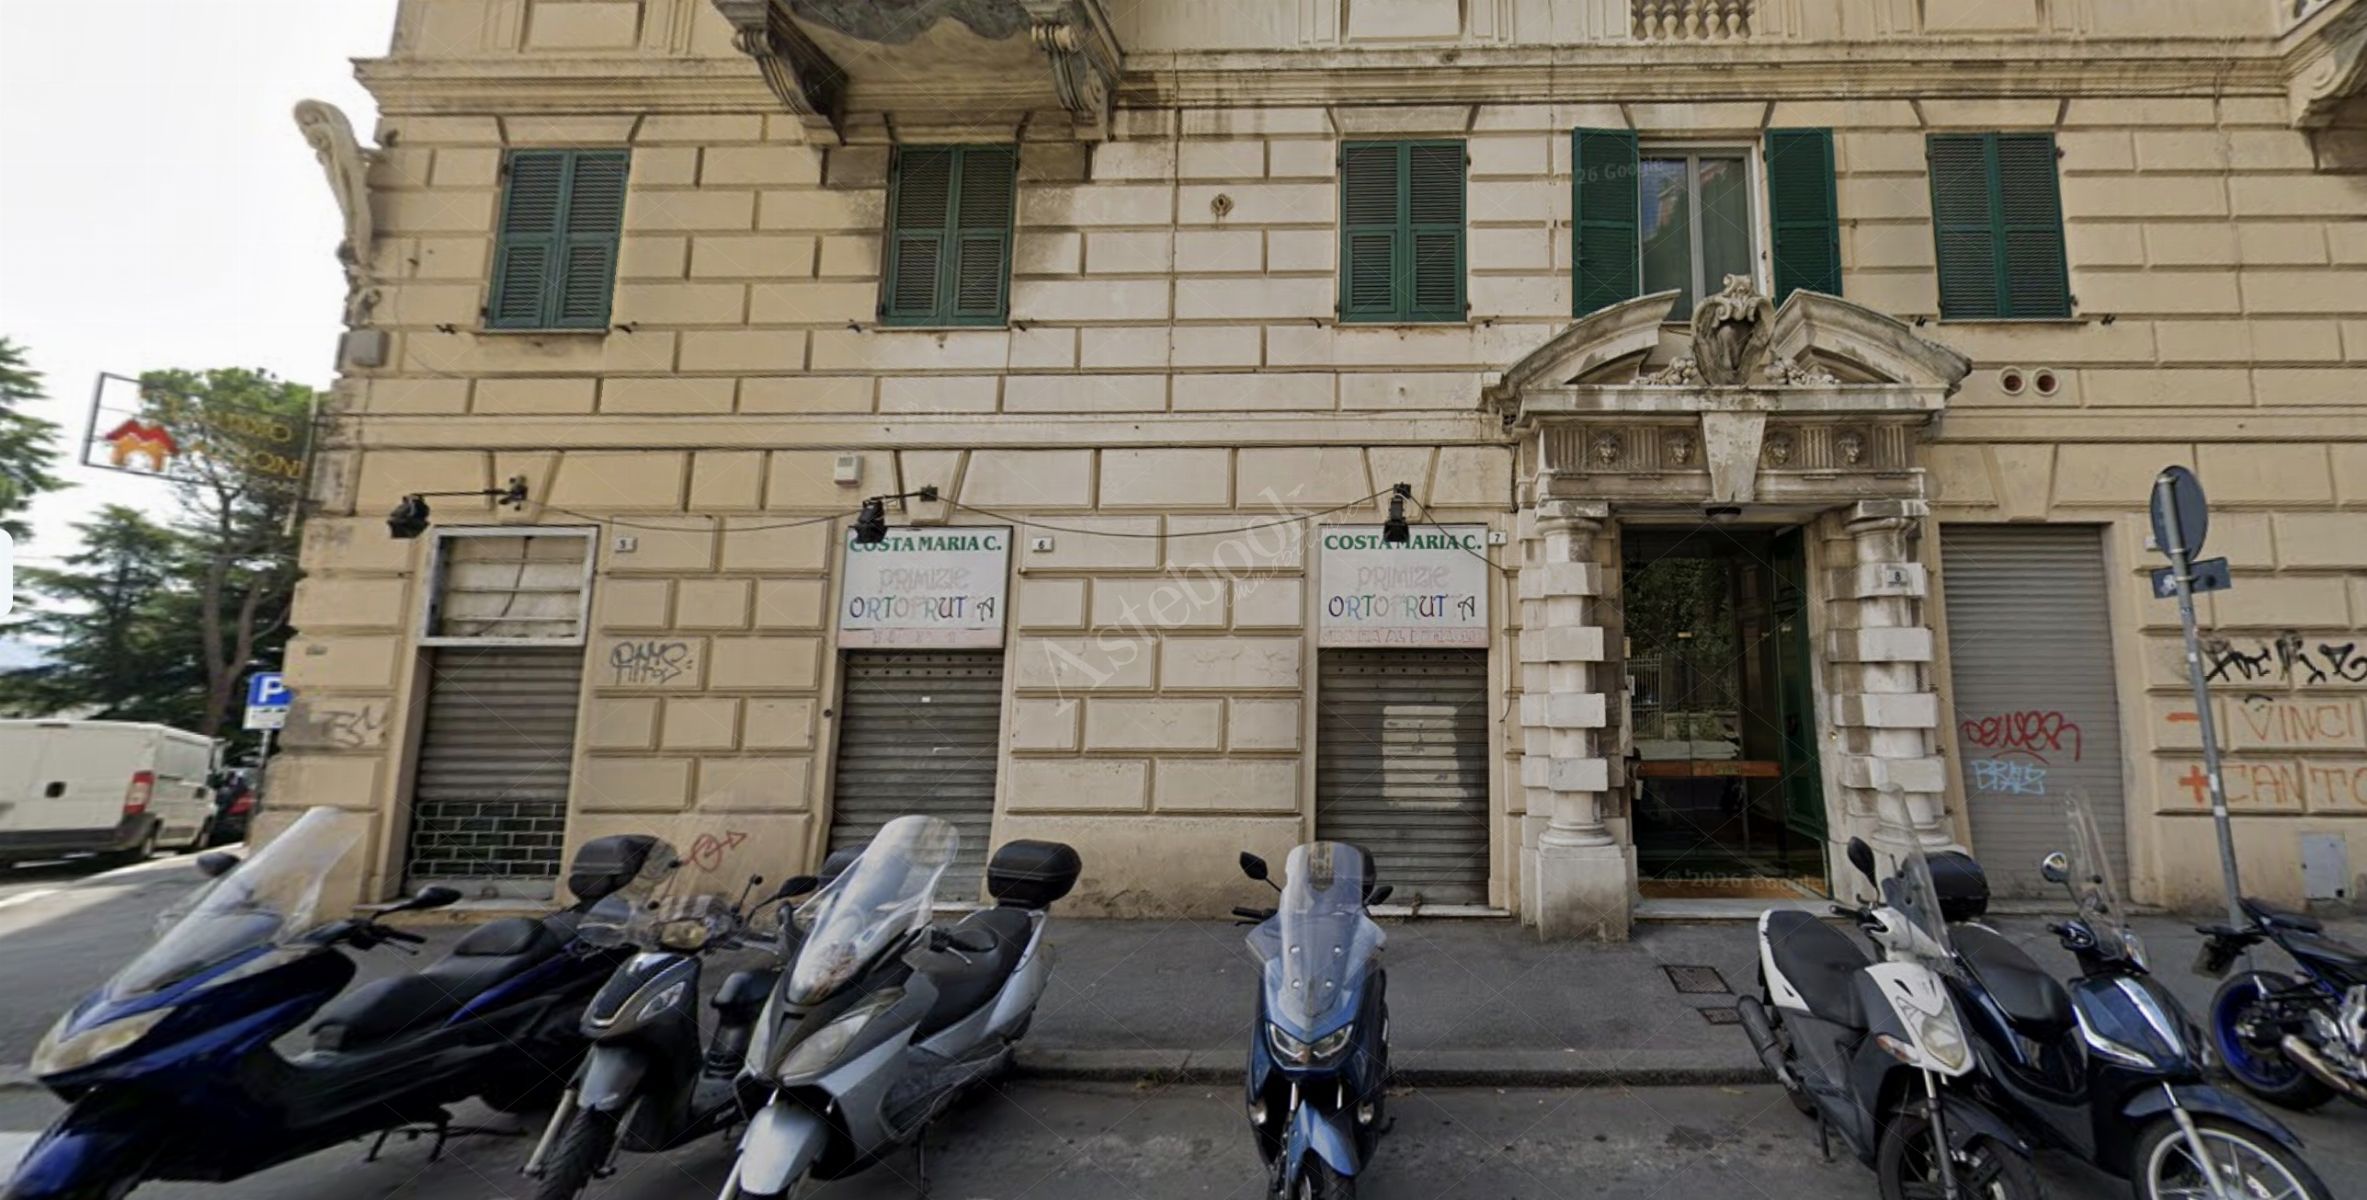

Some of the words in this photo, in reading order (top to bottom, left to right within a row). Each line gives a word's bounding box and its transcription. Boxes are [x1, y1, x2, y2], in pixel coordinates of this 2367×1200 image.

[919, 535, 980, 551] MARIA
[983, 535, 1003, 551] C.
[1038, 539, 1045, 550] 6
[1463, 534, 1482, 550] C.
[1495, 533, 1501, 543] 7
[257, 676, 285, 702] P
